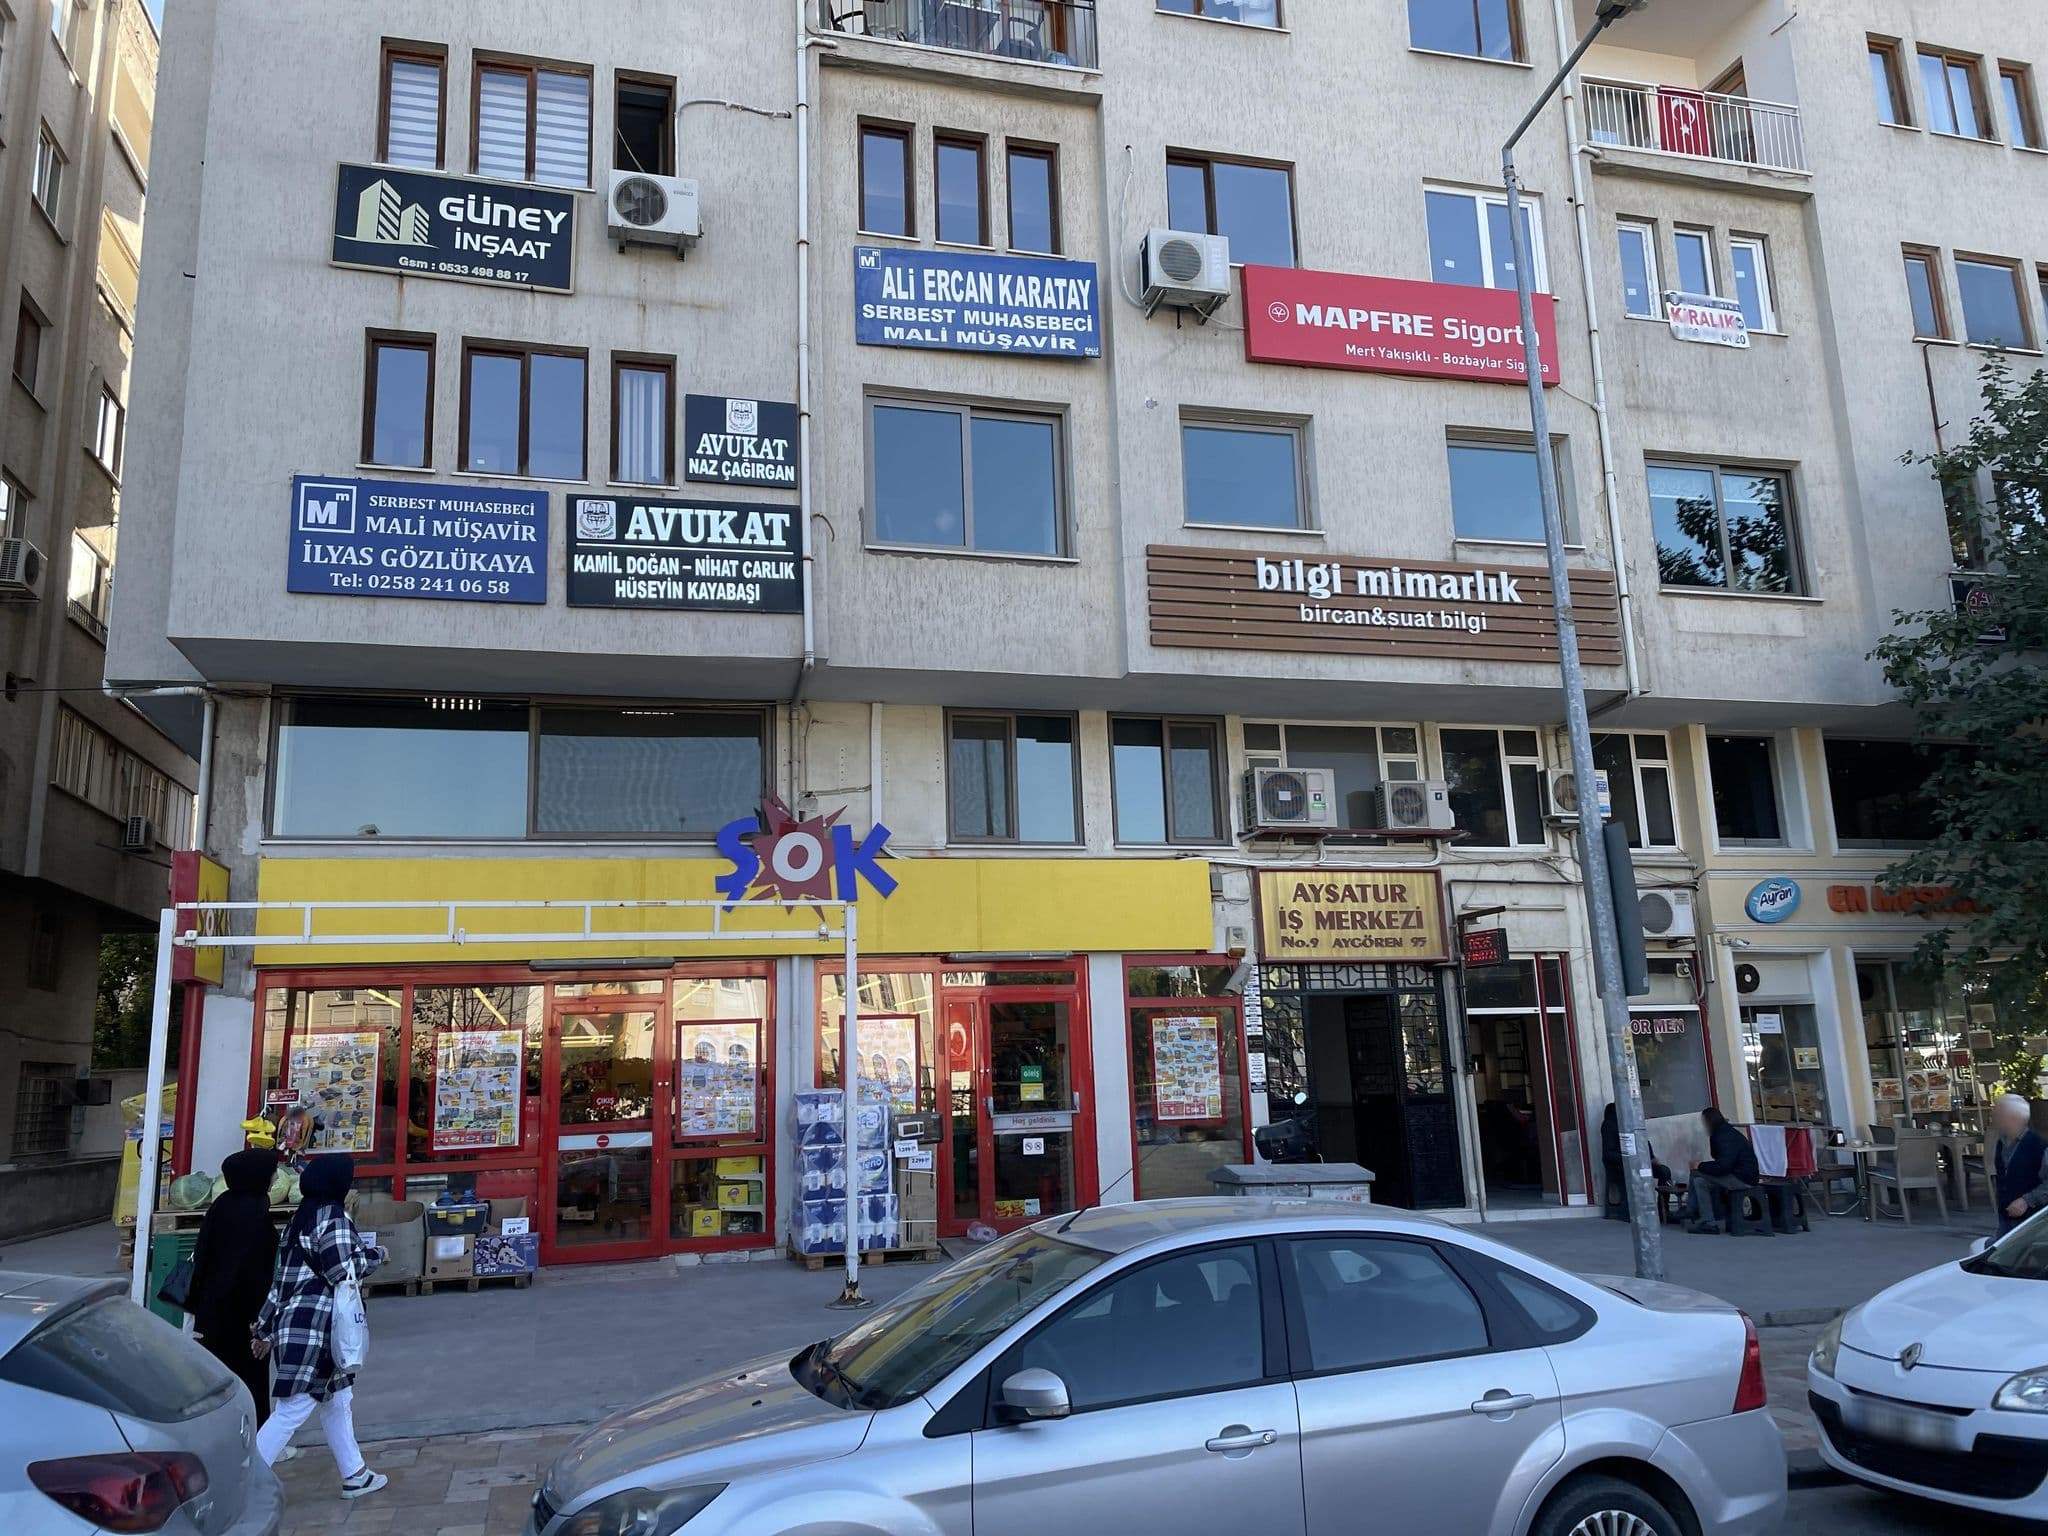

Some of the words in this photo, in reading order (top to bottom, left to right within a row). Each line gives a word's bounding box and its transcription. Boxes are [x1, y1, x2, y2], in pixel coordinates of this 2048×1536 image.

[454, 227, 552, 260] İNŞAAT
[398, 256, 428, 270] Gsm
[438, 262, 469, 274] 0533
[471, 266, 494, 278] 498
[496, 270, 512, 281] 88
[514, 271, 529, 282] 17
[923, 269, 993, 305] ERCAN
[998, 273, 1091, 311] KARATAY
[862, 304, 956, 323] SERBEST
[963, 309, 1093, 333] MUHASEBECİ
[1296, 303, 1434, 338] MAPFRE
[883, 326, 948, 343] MALİ
[956, 330, 1077, 351] MÜŞAVİR
[1345, 344, 1376, 359] Mert
[1378, 346, 1431, 364] Yakışıklı
[1442, 351, 1503, 370] Bozbaylar
[696, 433, 789, 461] AVUKAT
[688, 458, 718, 476] NAZ
[721, 458, 795, 482] ÇAĞIRGAN
[369, 495, 436, 510] SERBEST
[439, 499, 535, 516] MUHASEBECİ
[365, 515, 426, 536] MALİ
[432, 518, 537, 544] MÜŞAVİR
[624, 506, 790, 547] AVUKAT
[302, 539, 374, 566] İLYAS
[381, 545, 536, 574] GÖZLÜKAYA
[573, 551, 623, 574] KAMİL
[626, 553, 679, 576] DOĞAN
[695, 555, 739, 577] NİHAT
[330, 572, 362, 588] Tel:
[368, 575, 416, 590] 0258
[420, 577, 455, 592] 241
[460, 580, 482, 593] 06
[487, 581, 510, 594] 58
[615, 576, 683, 600] HÜSEYİN
[687, 582, 760, 604] KAYABAŞI
[1256, 557, 1342, 600] bilgi
[1357, 566, 1522, 604] mimarlık
[1300, 603, 1434, 629] bircan&suat
[1440, 609, 1487, 635] bilgi
[714, 814, 900, 914] ŞOK
[1292, 882, 1408, 903] AYSATUR
[1760, 887, 1793, 907] Ayran
[1279, 906, 1303, 934] İŞ
[1315, 905, 1424, 930] MERKEZİ
[1280, 935, 1319, 949] No.9
[1332, 934, 1403, 948] AYGÖREN
[1653, 1018, 1684, 1034] MEN
